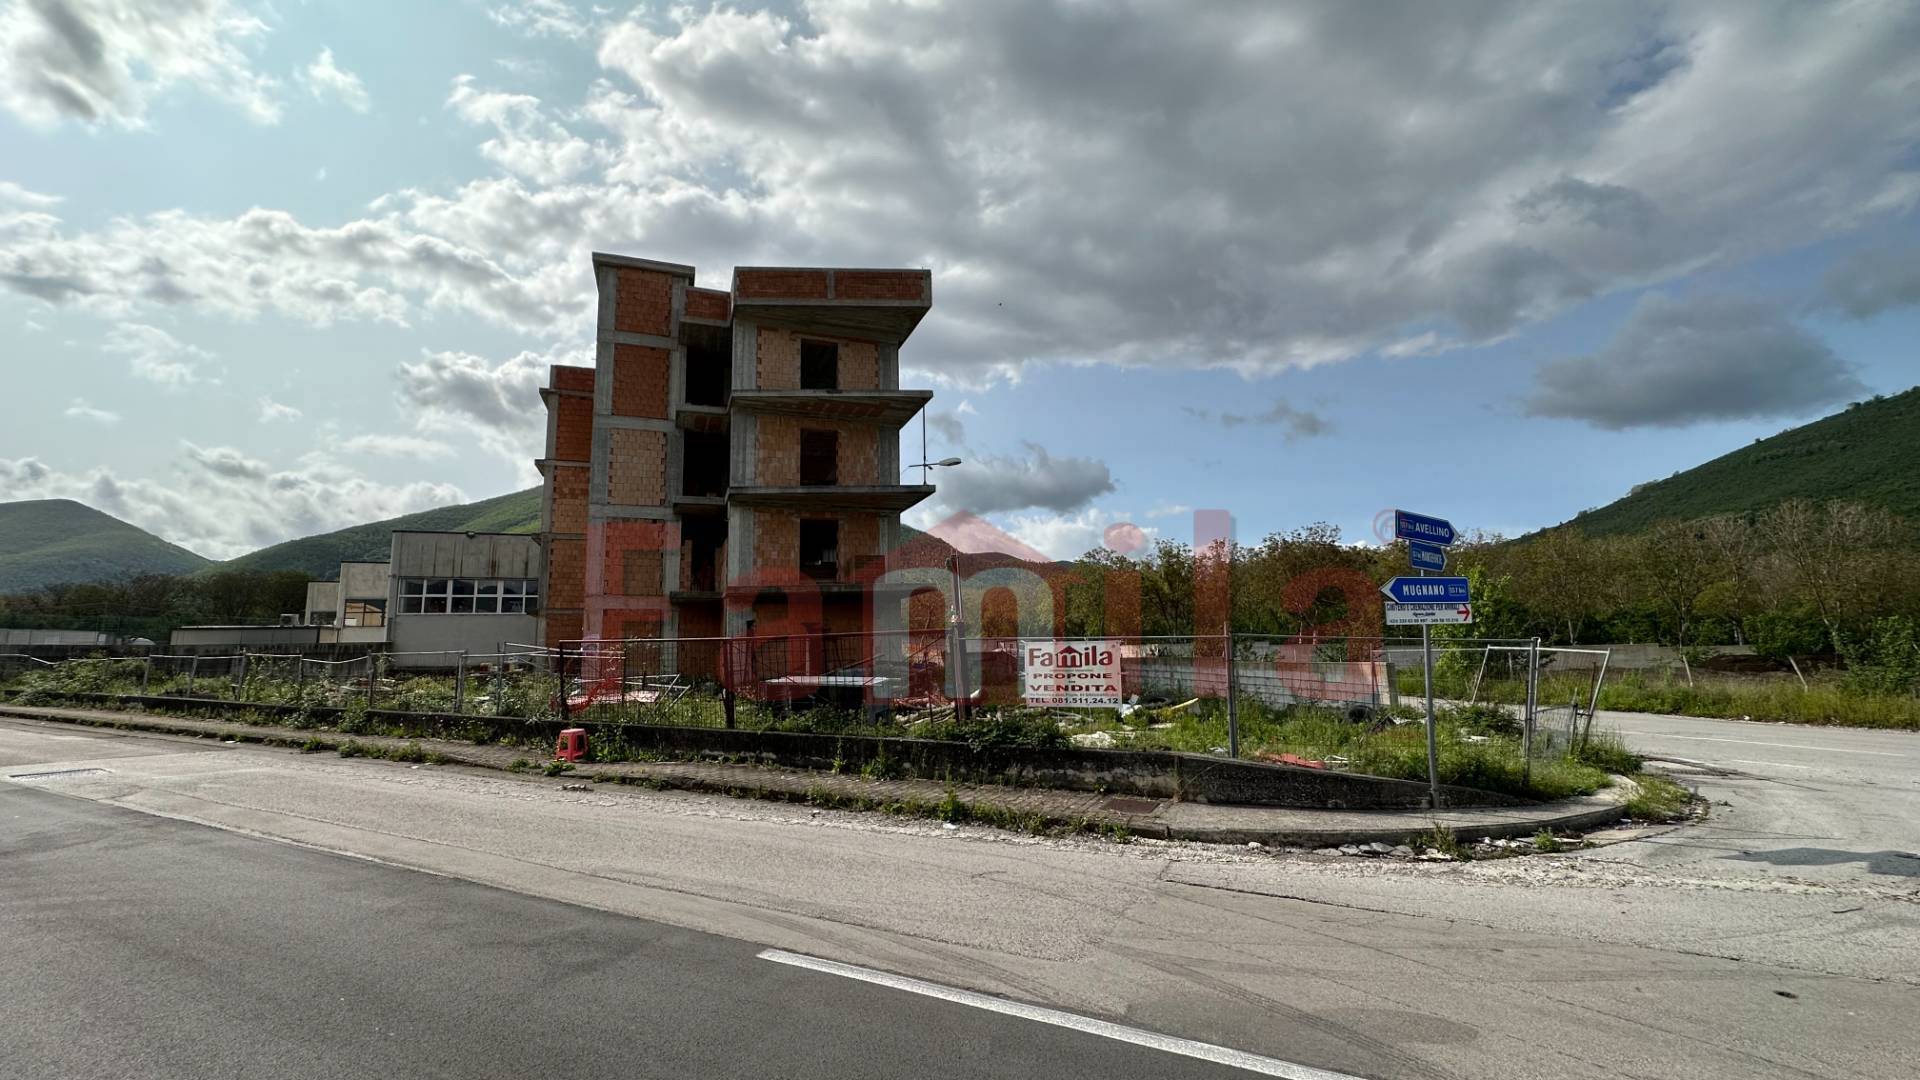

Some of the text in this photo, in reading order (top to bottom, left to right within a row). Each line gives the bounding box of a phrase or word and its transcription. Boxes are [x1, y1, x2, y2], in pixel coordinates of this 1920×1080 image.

[1415, 522, 1450, 538] AVELLINO
[1403, 584, 1445, 596] MUGNANO
[1029, 645, 1113, 668] Famila
